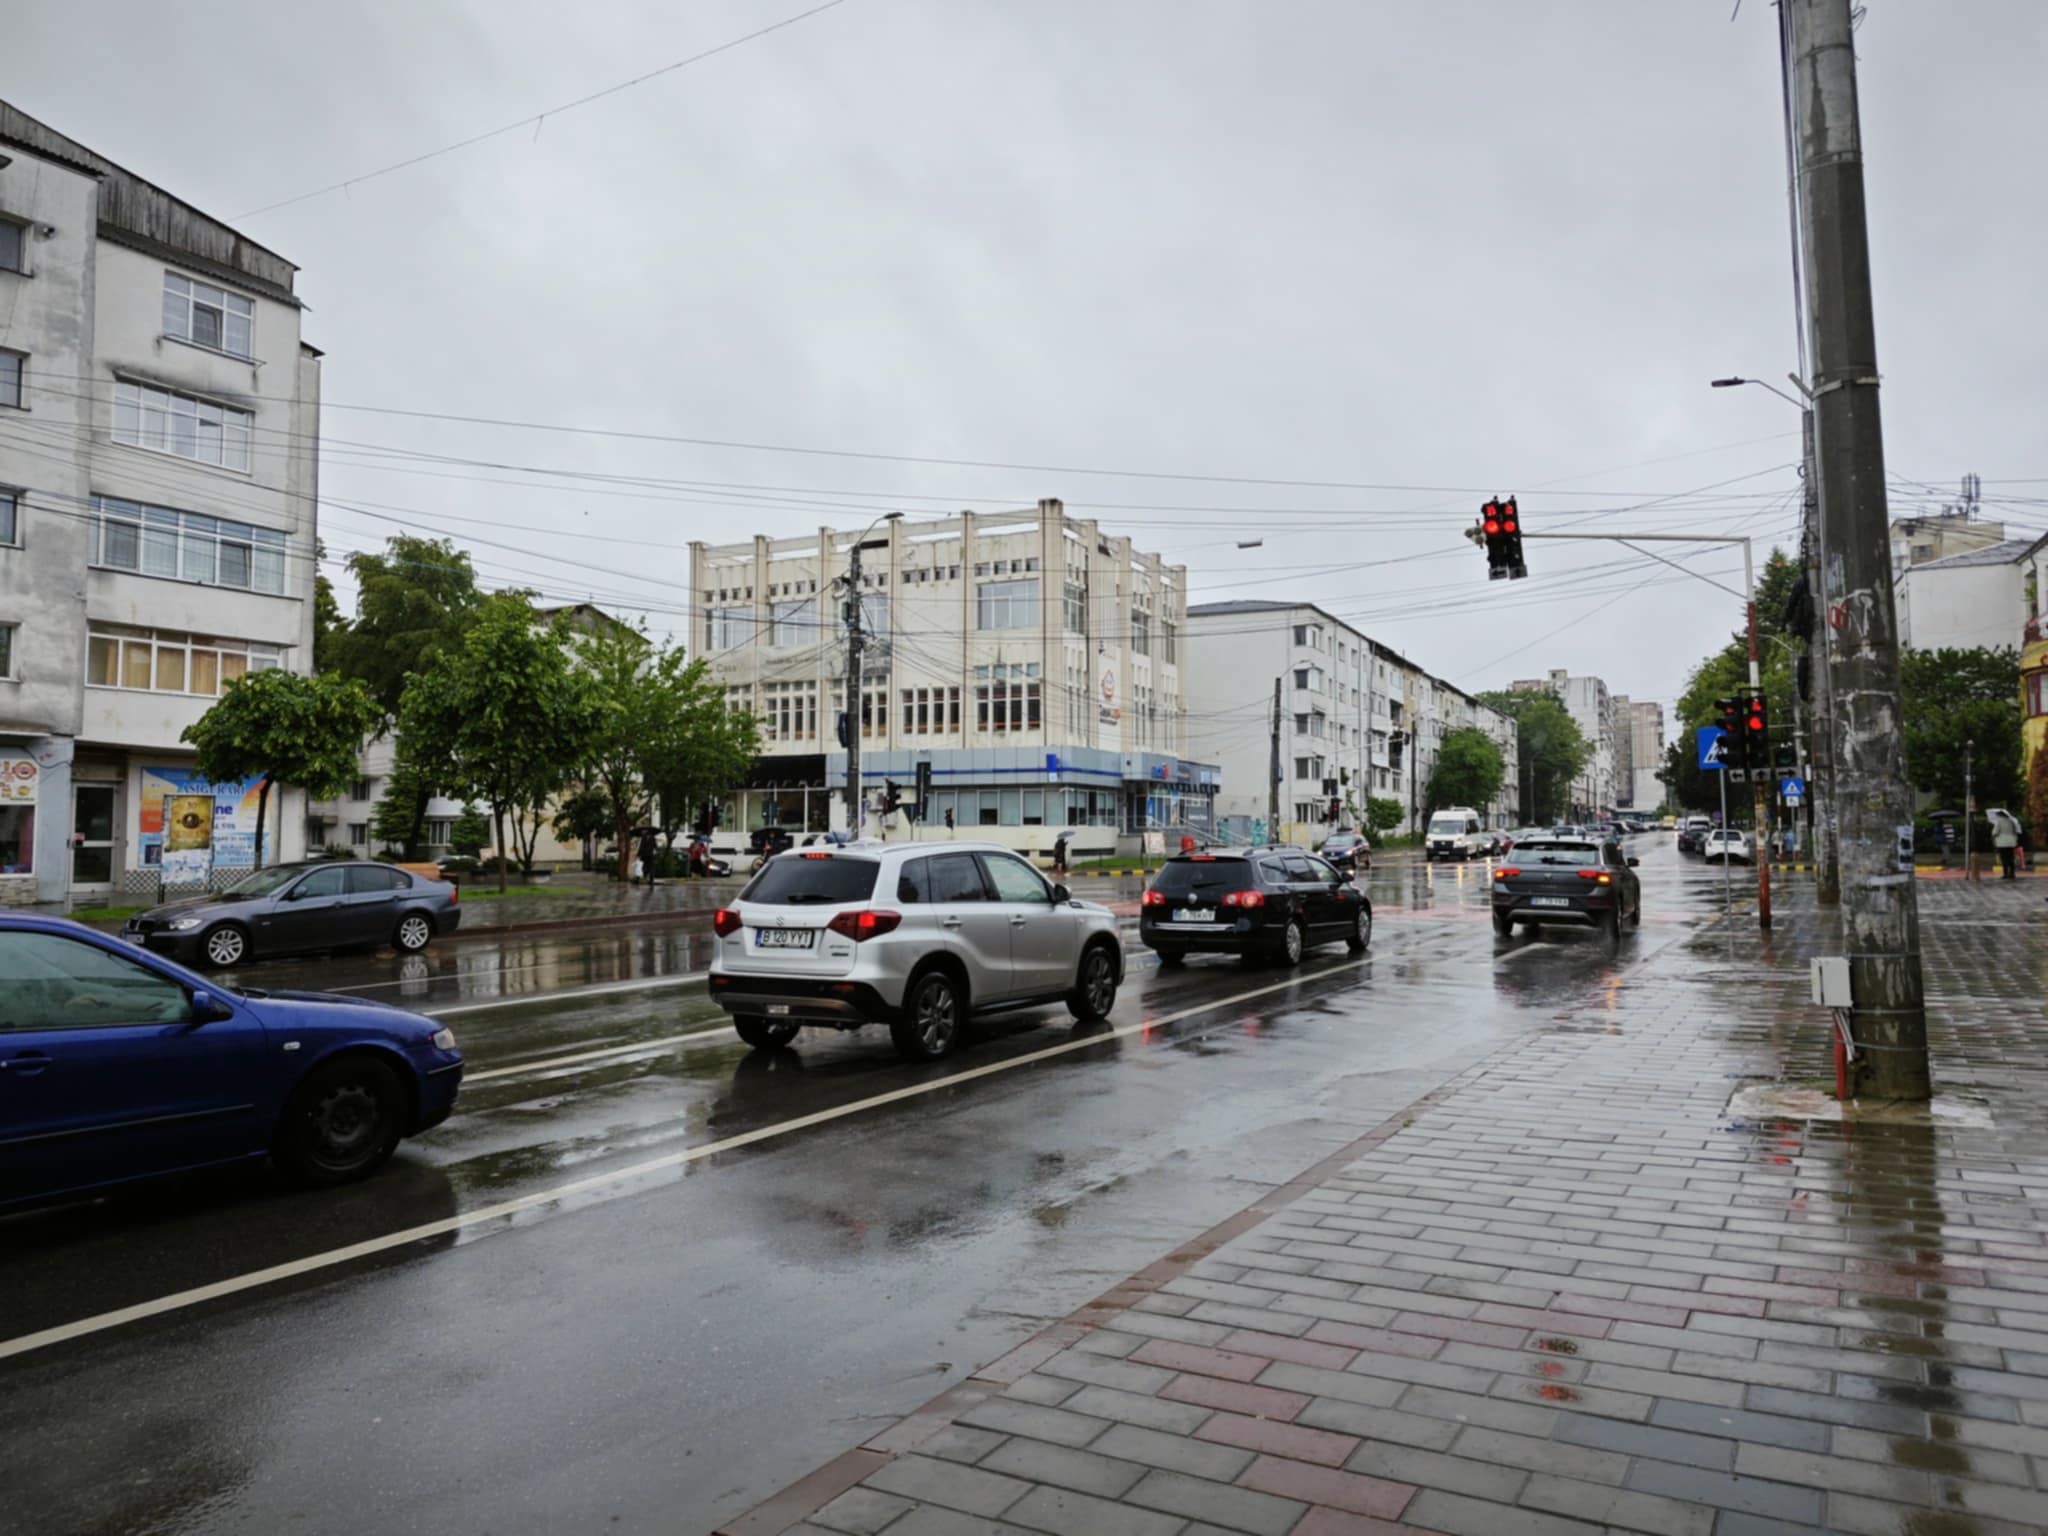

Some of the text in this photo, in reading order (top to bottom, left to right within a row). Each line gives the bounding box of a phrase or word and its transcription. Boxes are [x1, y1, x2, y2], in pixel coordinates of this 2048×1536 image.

[763, 930, 809, 944] B 120 YYT
